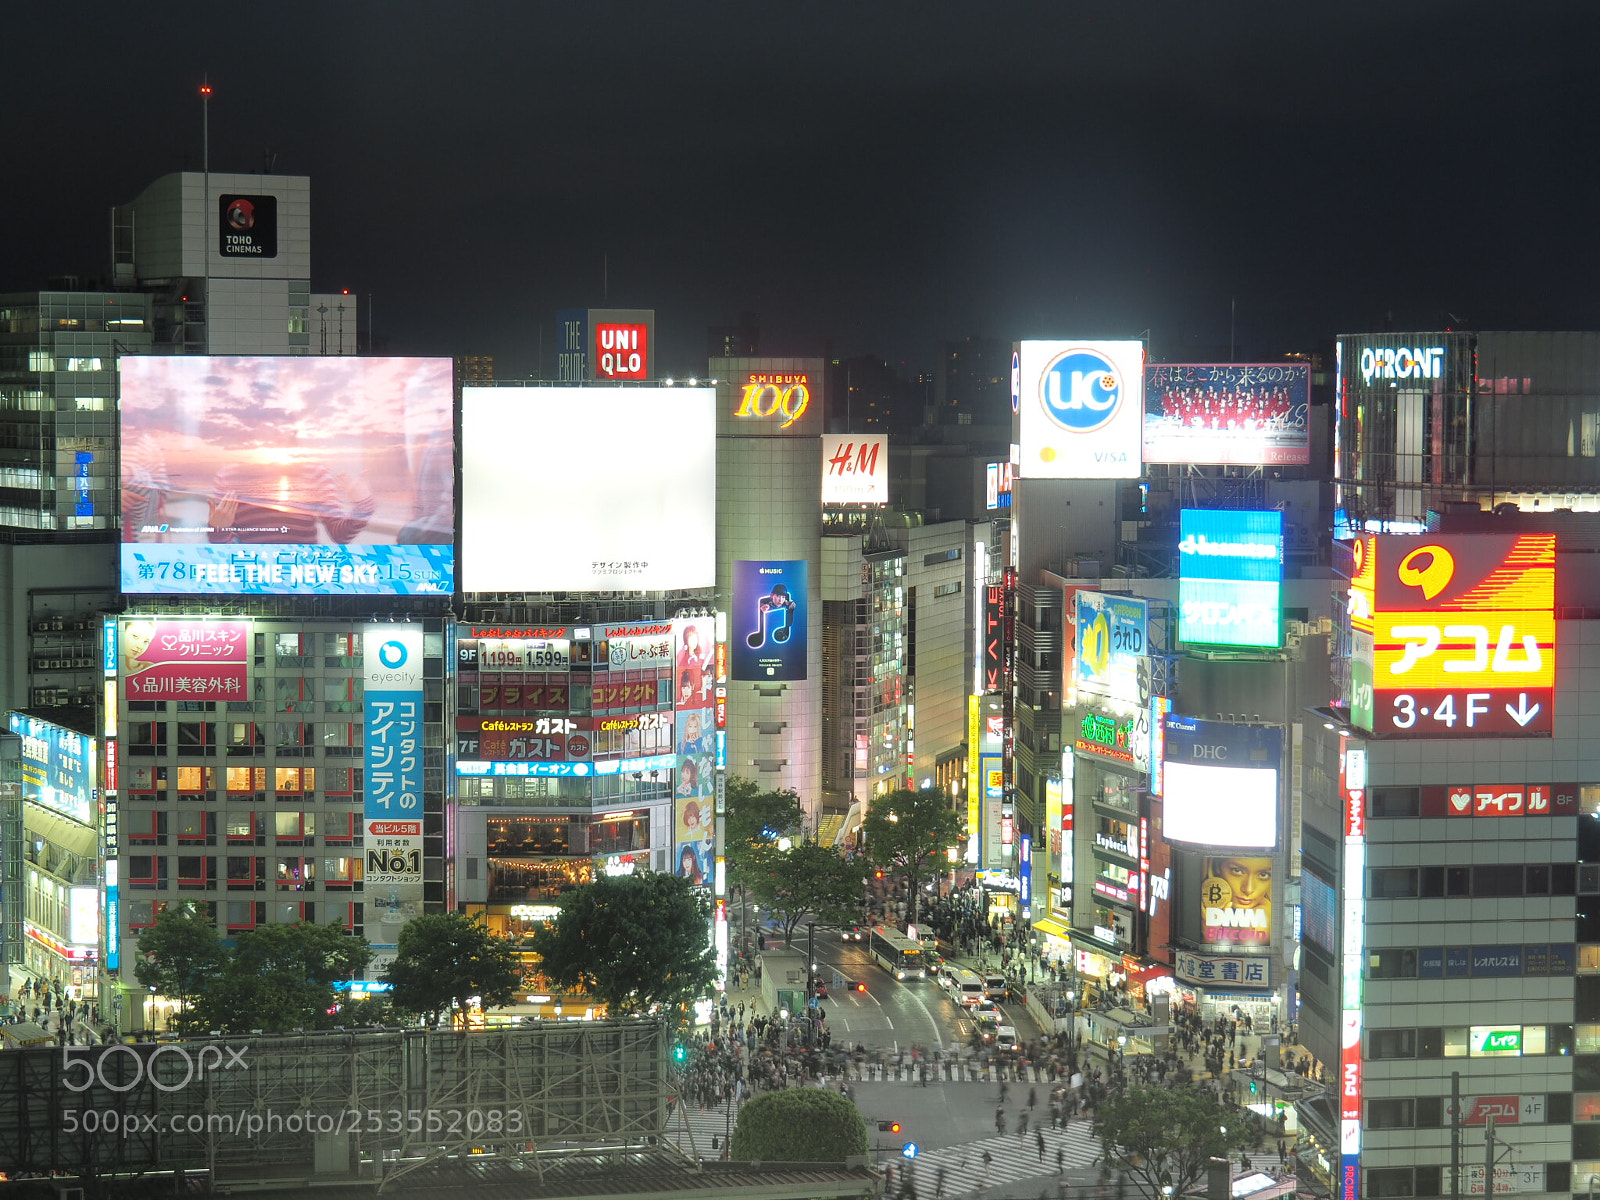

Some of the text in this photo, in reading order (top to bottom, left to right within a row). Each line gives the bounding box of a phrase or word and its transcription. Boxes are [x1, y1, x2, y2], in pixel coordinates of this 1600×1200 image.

[226, 236, 252, 244] TOHO
[226, 245, 262, 253] CINEMAS
[565, 321, 580, 349] THE
[602, 330, 638, 350] UNI
[559, 353, 586, 381] PRIME
[602, 353, 641, 375] QLO
[1361, 348, 1444, 387] QFRONT
[750, 375, 808, 384] SHIBUYA
[734, 384, 810, 428] 109
[829, 442, 880, 476] H&M
[1095, 452, 1127, 462] VISA
[1271, 452, 1308, 462] Release
[196, 564, 378, 583] FEEL THE NEW SKY
[413, 571, 441, 580] SUN
[178, 629, 241, 643] 品川スキン
[471, 627, 567, 638] しゃぶしゃぶバイキング
[605, 624, 673, 638] しゃぶしゃぶバイキング
[179, 644, 235, 656] クリニック
[460, 649, 476, 661] 9F
[630, 642, 670, 659] しゃぶ葉
[1390, 625, 1542, 674] アコム
[481, 651, 522, 669] 1,199円
[526, 651, 569, 669] 1,599円
[143, 677, 241, 694] 品川美容外科
[371, 671, 416, 685] eyecity
[481, 686, 566, 704] プライス
[592, 683, 656, 703] コンタクト
[535, 718, 577, 735] ガスト
[638, 713, 669, 731] ガスト
[459, 740, 479, 753] 7F
[483, 739, 507, 749] Café
[508, 738, 561, 759] ガスト
[1193, 744, 1228, 760] DHC
[371, 702, 395, 809] アイシティ
[400, 702, 417, 809] コンタクトの
[1476, 792, 1547, 811] アイフル
[1556, 794, 1573, 805] 8F
[375, 824, 417, 834] 当ビル5階
[377, 838, 410, 847] 利用者数
[367, 849, 421, 874] No.1
[1206, 907, 1268, 928] DMM
[1206, 926, 1268, 941] Bitcoin
[1177, 956, 1264, 981] 大盛堂書店
[1491, 1035, 1517, 1046] レイク
[1478, 1104, 1517, 1117] アコム
[1525, 1103, 1542, 1114] 4F
[1524, 1172, 1540, 1183] 3F
